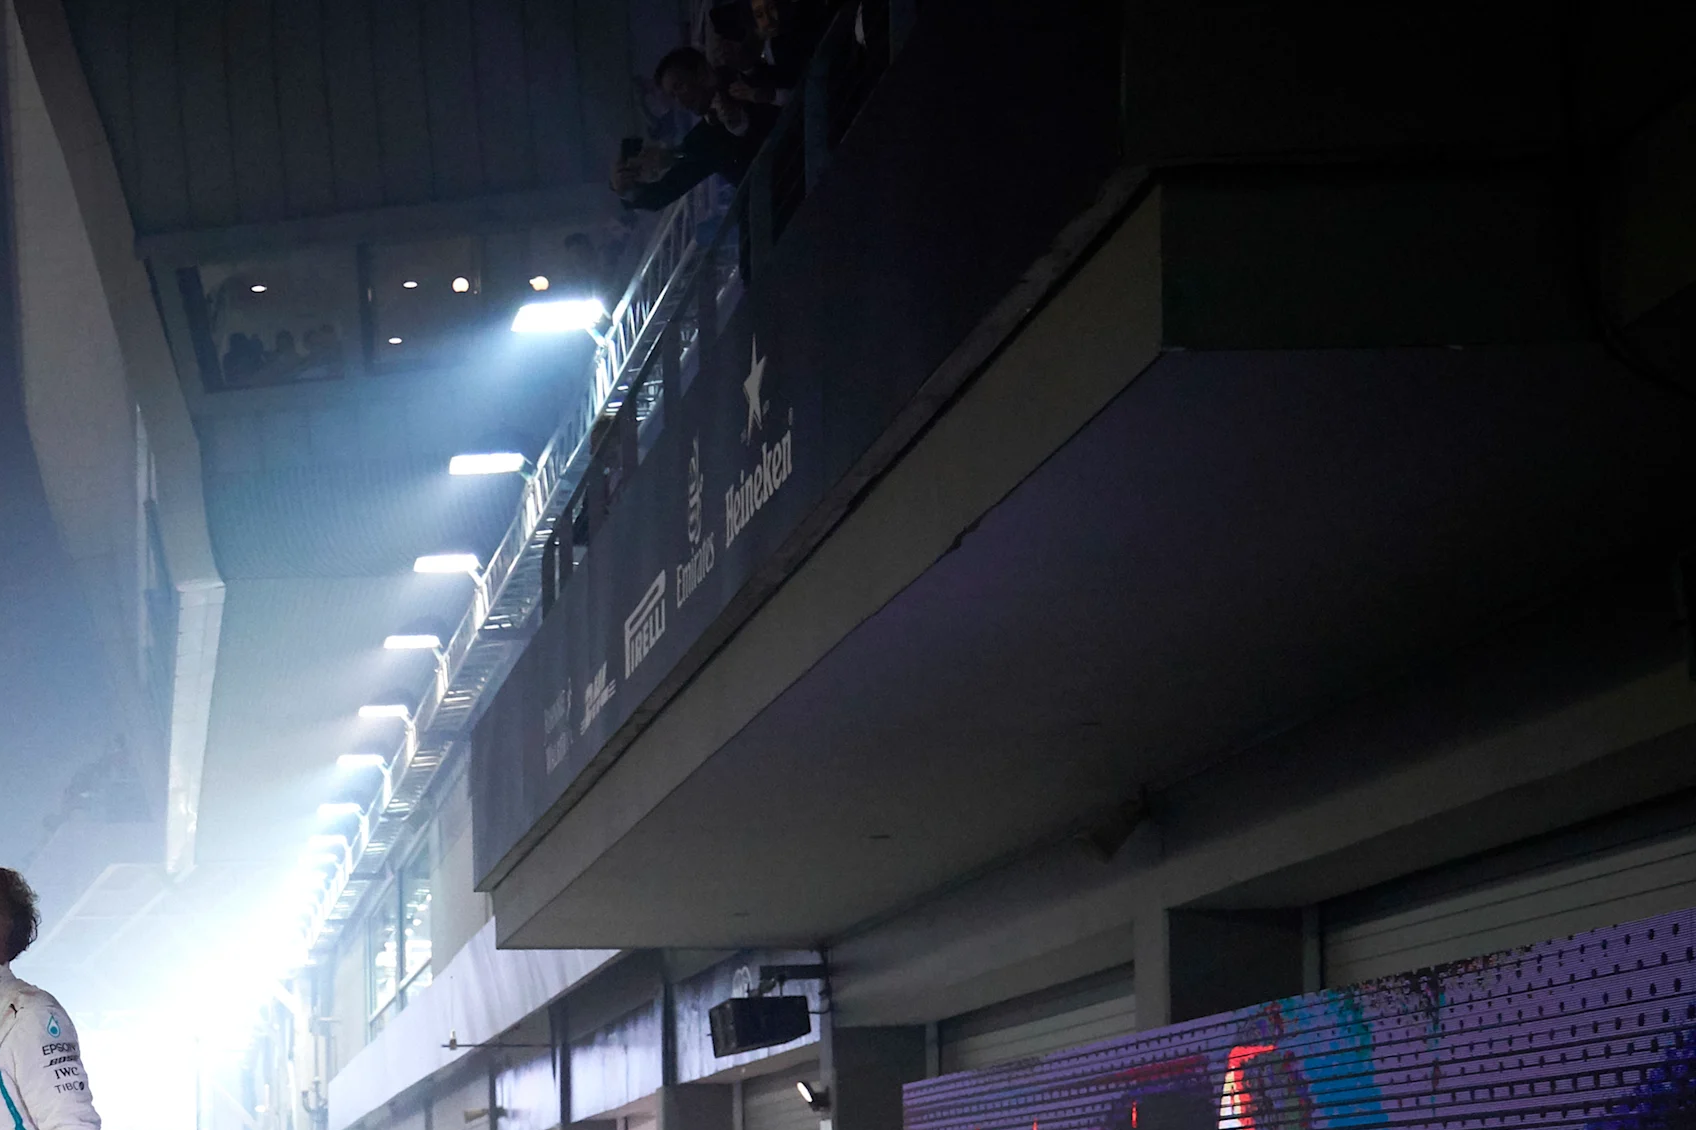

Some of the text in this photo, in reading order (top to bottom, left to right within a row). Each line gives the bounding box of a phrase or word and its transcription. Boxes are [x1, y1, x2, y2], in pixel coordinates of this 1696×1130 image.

[725, 429, 793, 549] Heineken
[676, 531, 715, 609] Emirates
[625, 568, 667, 680] PIRELLI
[42, 1042, 76, 1056] EPSON
[54, 1066, 80, 1079] IWC
[54, 1080, 85, 1094] TIBCO
